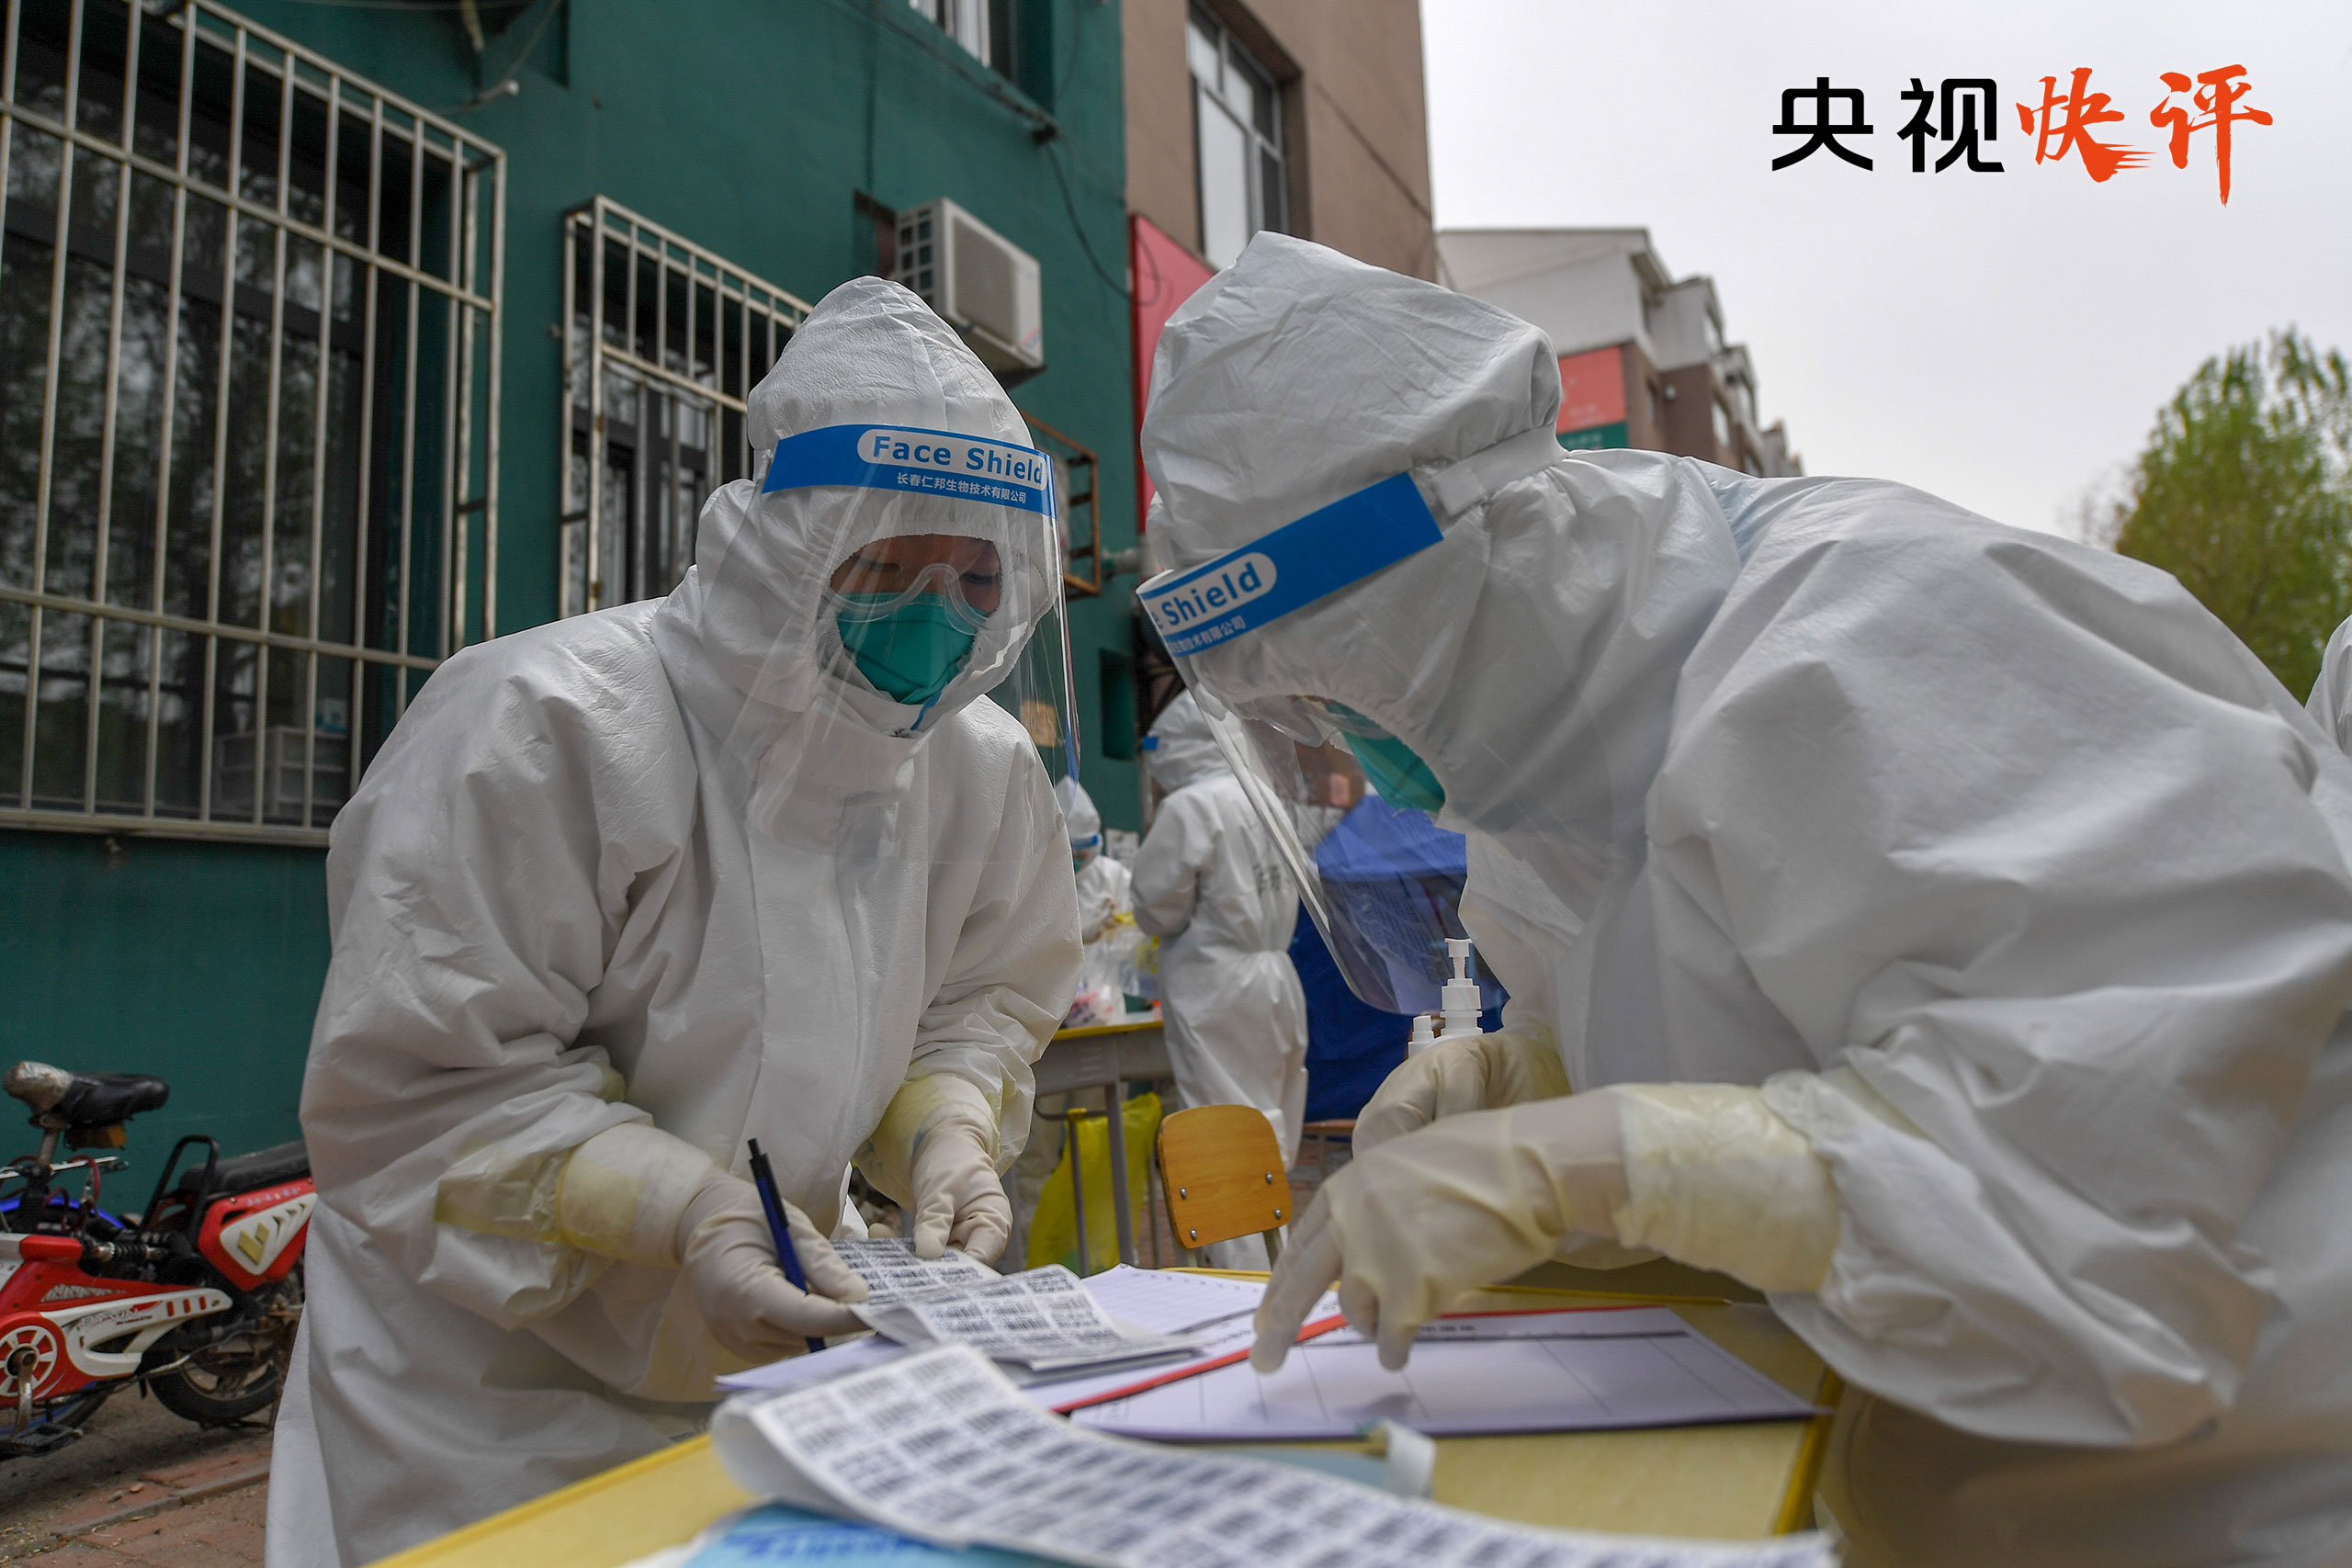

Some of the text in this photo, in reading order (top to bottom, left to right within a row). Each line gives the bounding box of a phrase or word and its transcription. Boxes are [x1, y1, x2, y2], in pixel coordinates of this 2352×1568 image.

[873, 435, 1043, 484] Face Shield
[897, 472, 1026, 504] 长春仁邦生物技术有限公司
[1162, 561, 1261, 626] Shield
